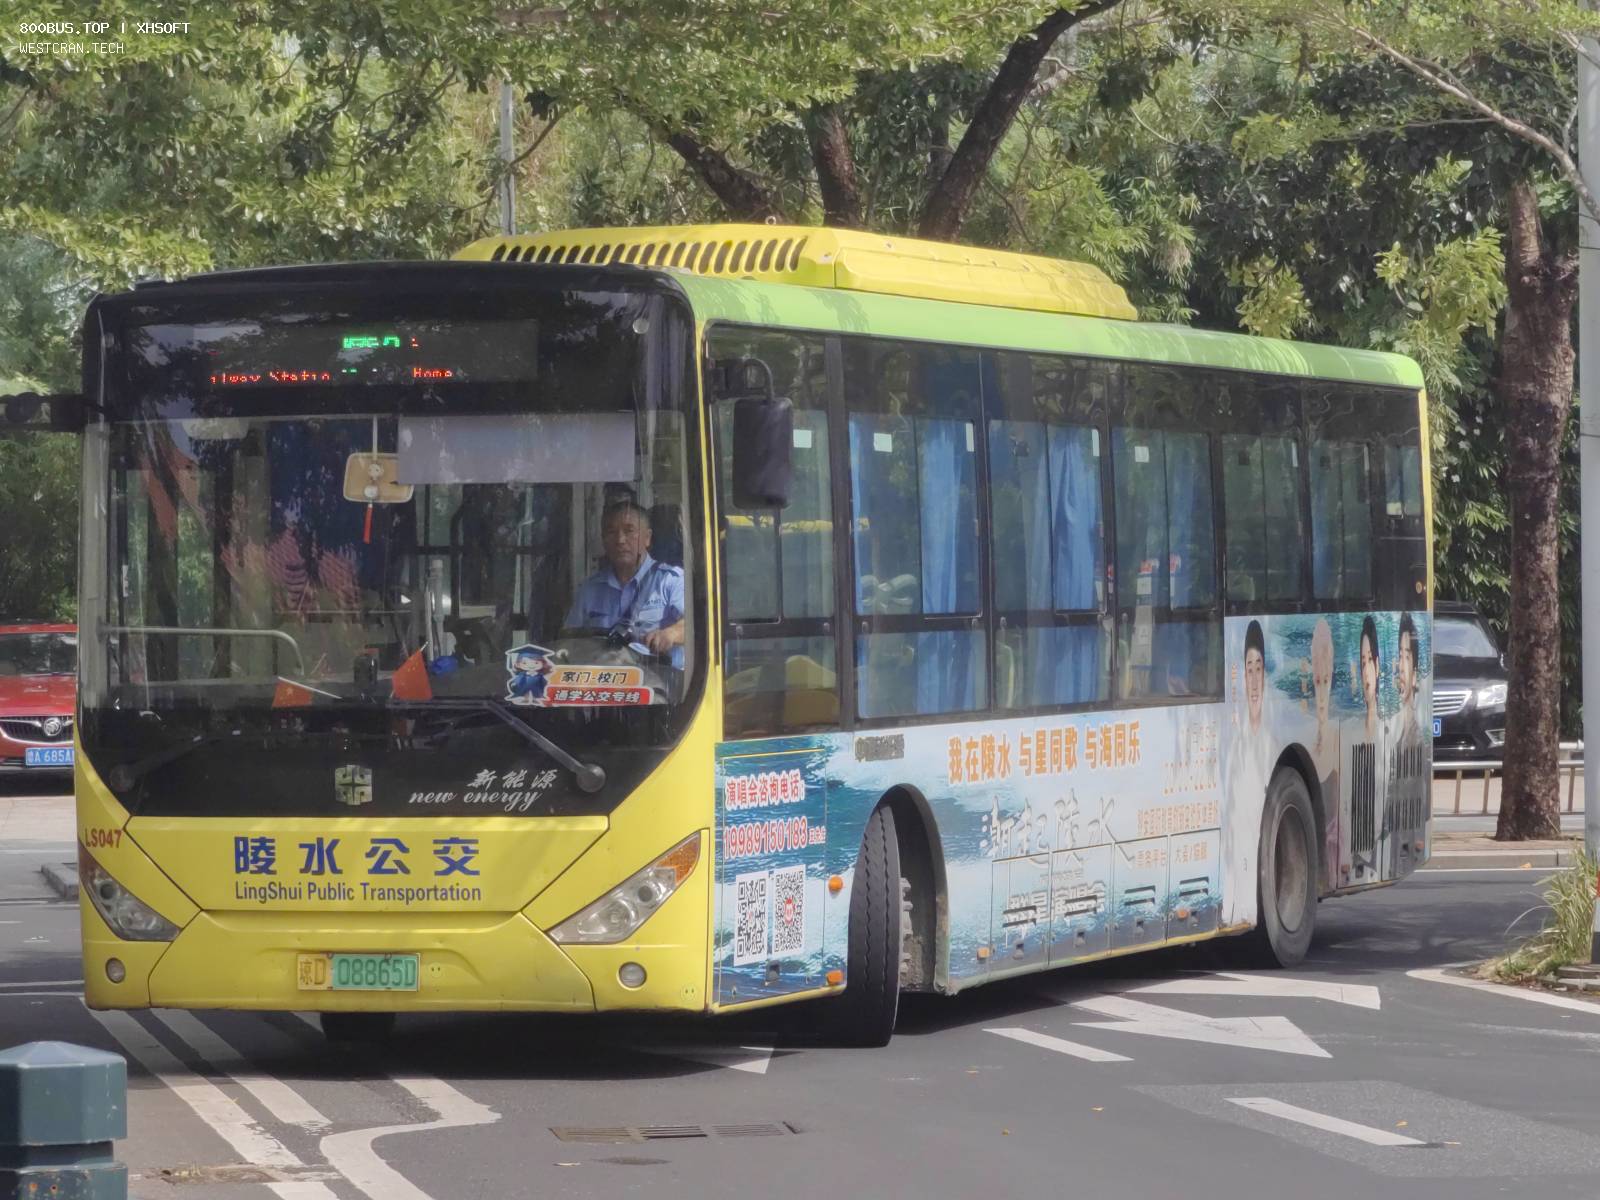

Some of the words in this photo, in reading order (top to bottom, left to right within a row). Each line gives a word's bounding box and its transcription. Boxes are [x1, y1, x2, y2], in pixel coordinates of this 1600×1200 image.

[561, 671, 628, 684] 家门-校门
[554, 690, 641, 703] 通学公交专线
[948, 733, 1012, 785] 我在陵水
[1018, 727, 1079, 777] 与星同歌
[1084, 720, 1142, 770] 与海同乐
[466, 768, 558, 790] 新能源
[408, 789, 456, 804] new
[462, 789, 543, 813] energy
[84, 827, 122, 849] LS047
[723, 817, 808, 859] 19989150183
[234, 836, 481, 876] 陵水公交
[235, 881, 302, 905] LingShui
[307, 881, 355, 902] Public
[360, 881, 481, 906] Transportation
